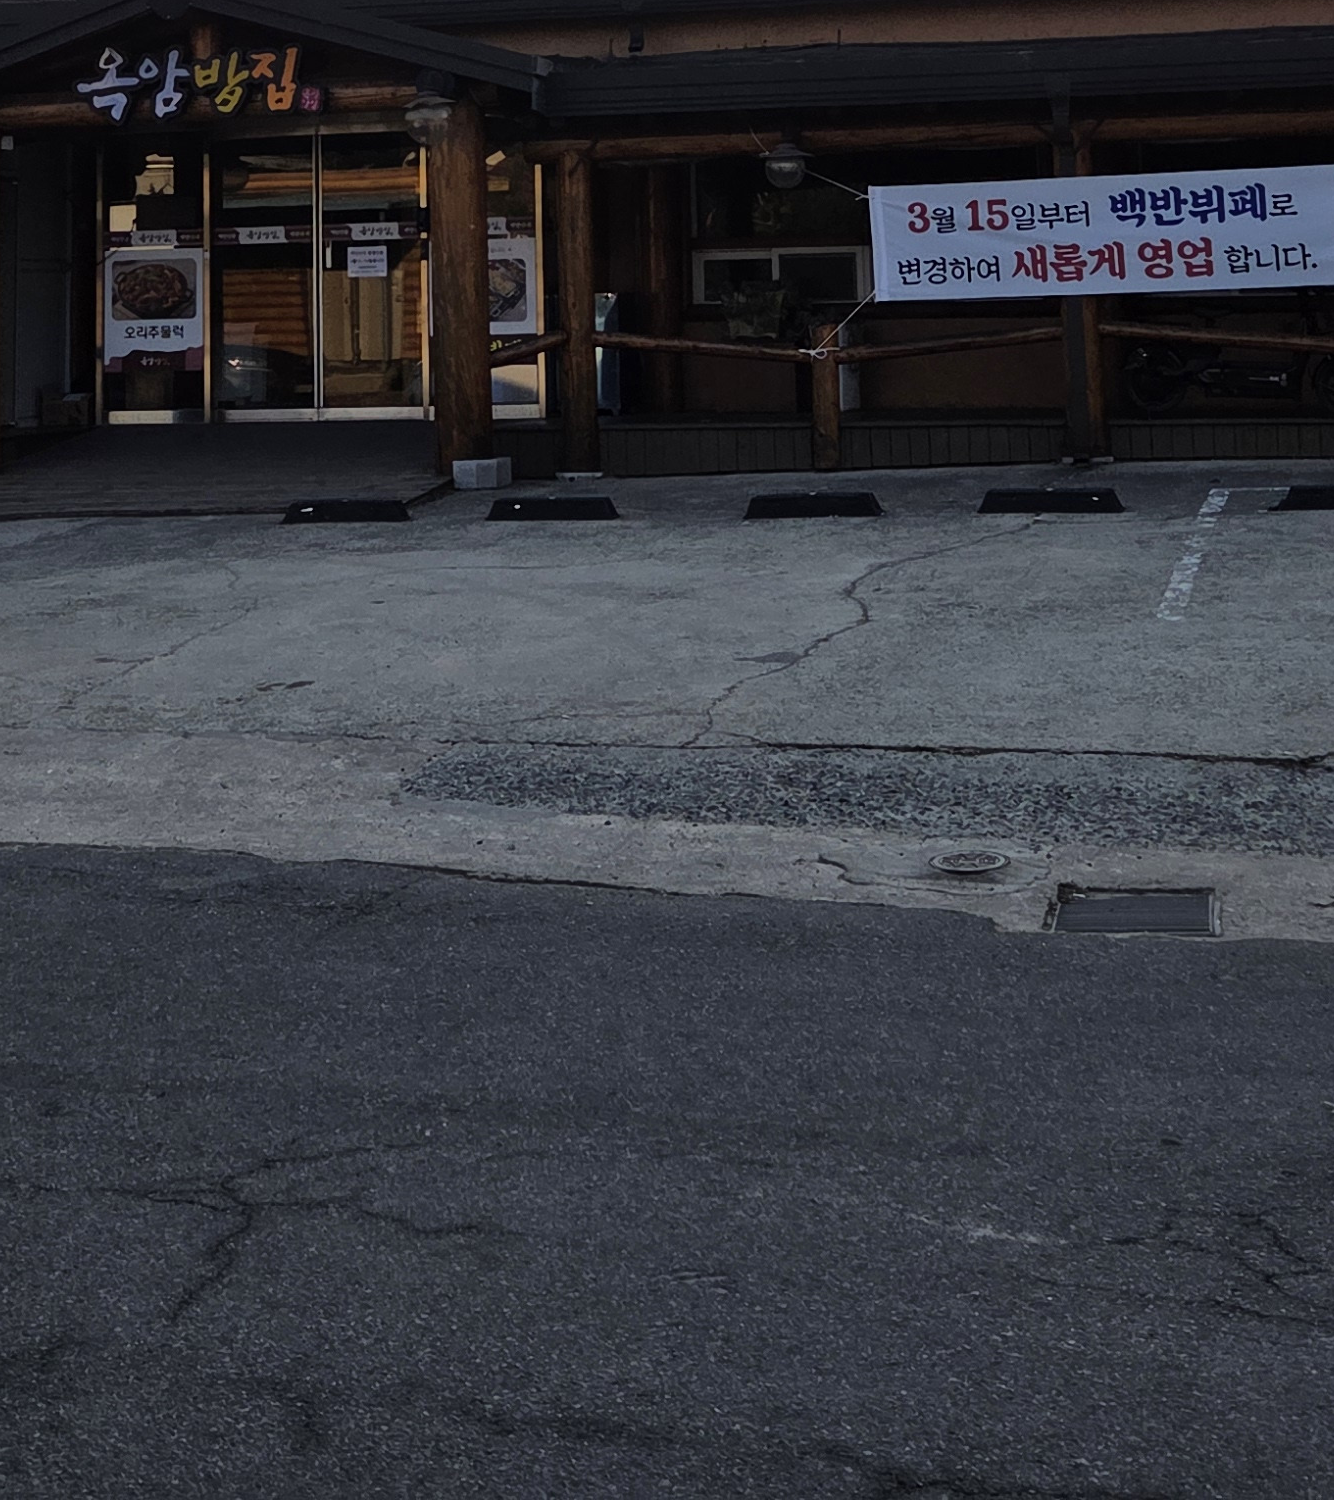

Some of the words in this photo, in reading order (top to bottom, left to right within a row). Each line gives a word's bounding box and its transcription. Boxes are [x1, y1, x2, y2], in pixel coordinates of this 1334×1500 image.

[76, 47, 298, 121] 옥암밥집
[907, 202, 957, 233] 3월
[965, 198, 1091, 231] 15일부터
[1109, 183, 1298, 228] 백반뷔페로
[897, 256, 1001, 285] 변경하여
[1012, 241, 1126, 283] 새롭게
[1137, 237, 1214, 279] 영업
[1224, 243, 1318, 275] 합니다.
[123, 324, 185, 340] 오리주물럭
